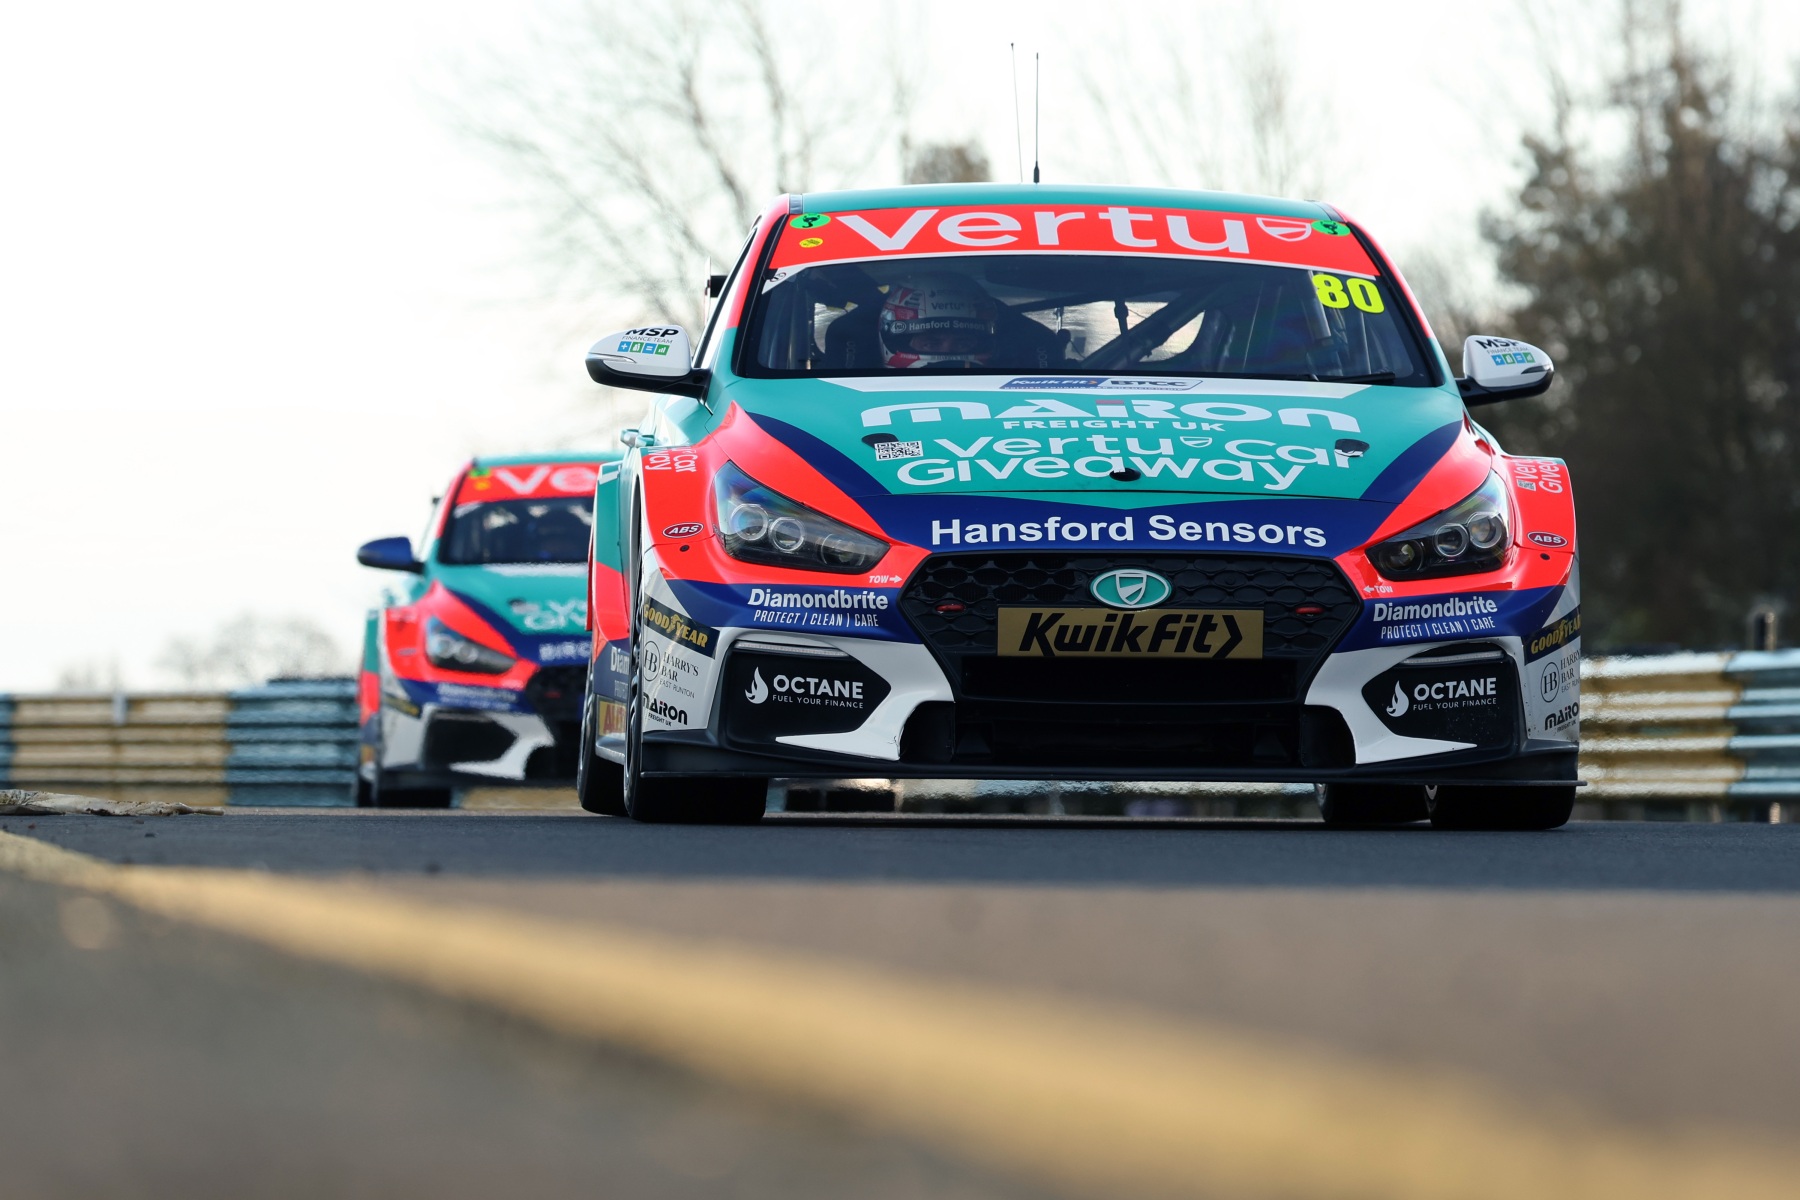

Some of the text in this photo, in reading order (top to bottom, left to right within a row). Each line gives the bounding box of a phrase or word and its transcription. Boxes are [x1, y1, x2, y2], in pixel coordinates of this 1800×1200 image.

[836, 207, 1250, 254] Vertu
[1312, 274, 1385, 314] 80
[625, 327, 679, 338] MSP
[909, 320, 950, 331] Hansford
[1003, 420, 1225, 432] FREIGHT UK
[935, 433, 1361, 469] Vertu Car
[672, 453, 698, 473] Car
[897, 454, 1305, 491] Giveaway
[668, 524, 699, 535] ABS
[932, 514, 1327, 548] Hansford Sensors
[1533, 534, 1562, 544] ABS
[868, 575, 889, 584] TOW
[1374, 585, 1394, 594] TOW
[747, 588, 889, 610] Diamondbrite
[1373, 595, 1498, 622] Diamondbrite
[643, 603, 708, 648] GOODYEAR
[753, 609, 879, 627] PROTECT CLEAN CARE
[1380, 616, 1496, 639] PROTECT CLEAN CARE
[644, 649, 658, 673] HB
[663, 651, 699, 677] HARRY'S
[661, 665, 679, 682] BAR
[1543, 671, 1558, 695] HB
[1561, 667, 1575, 684] BAR
[659, 679, 695, 699] EAST RUNTON
[773, 674, 864, 700] OCTANE
[1413, 677, 1497, 701] OCTANE
[1561, 681, 1572, 694] EAST
[772, 694, 864, 709] FUEL YOUR FINANCE
[1413, 698, 1497, 711] FUEL YOUR FINANCE
[648, 712, 665, 724] FREIGHT
